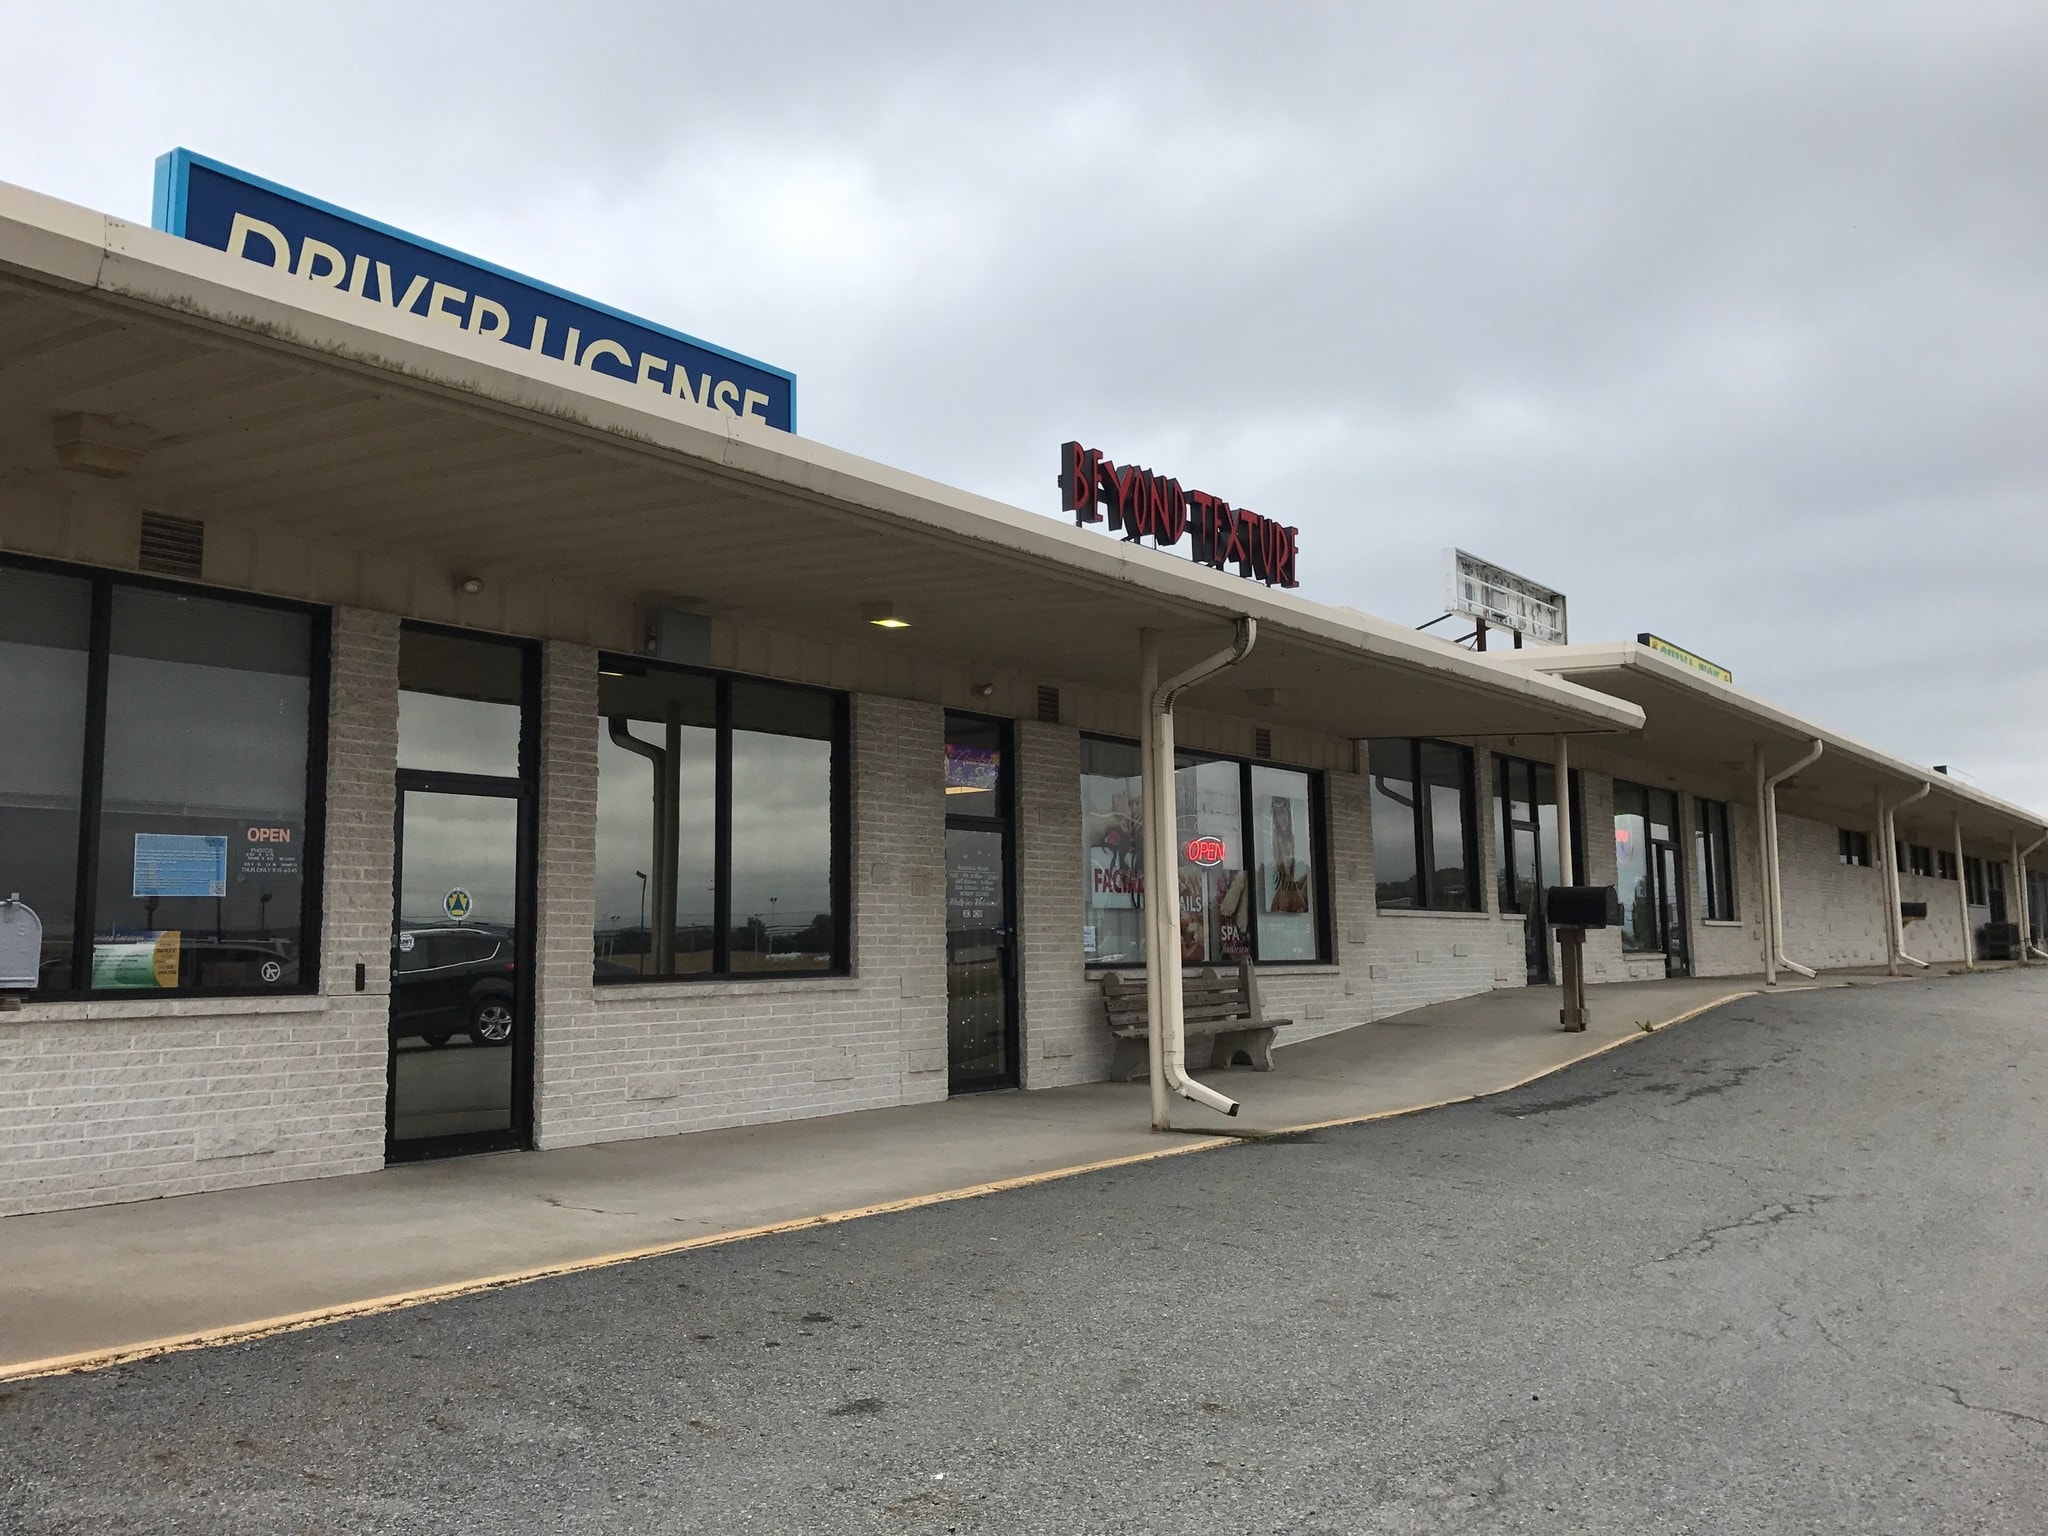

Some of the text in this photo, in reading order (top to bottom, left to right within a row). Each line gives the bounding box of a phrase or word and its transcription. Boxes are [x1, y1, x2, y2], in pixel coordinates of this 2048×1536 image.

[1061, 441, 1300, 588] BEYOND TEXTURE
[247, 827, 291, 843] OPEN
[1187, 840, 1226, 862] OPEN
[1179, 895, 1203, 913] AILS
[1221, 925, 1240, 942] SPA
